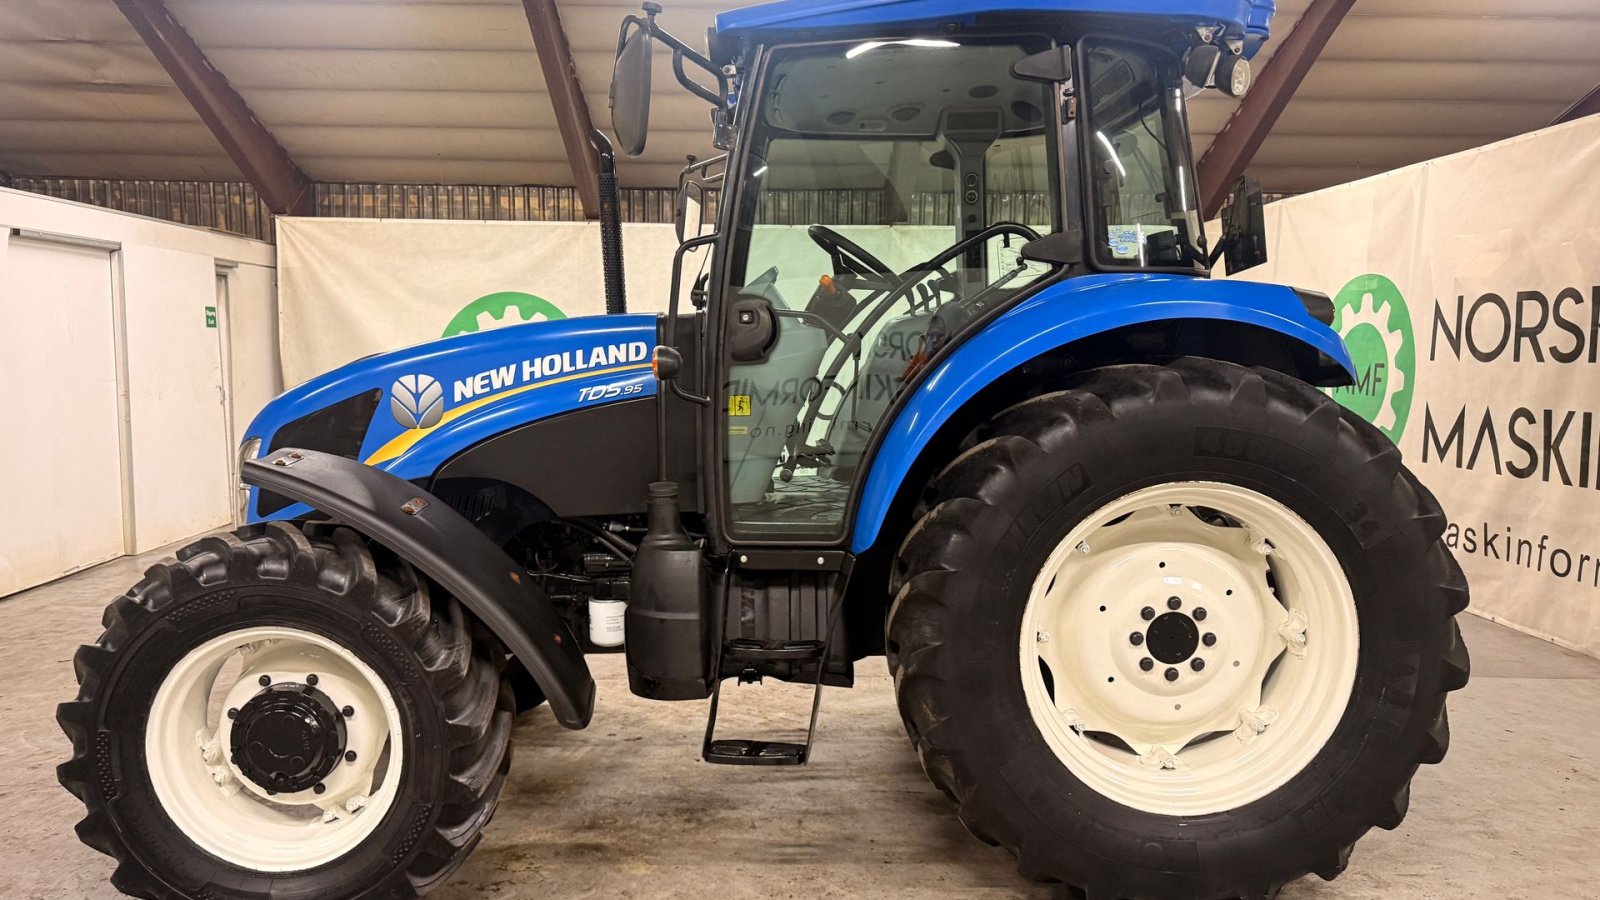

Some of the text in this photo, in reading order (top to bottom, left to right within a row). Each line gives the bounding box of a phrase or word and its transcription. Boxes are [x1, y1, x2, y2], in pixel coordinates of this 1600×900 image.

[454, 341, 648, 402] NEW HOLLAND
[1335, 363, 1385, 397] MF
[1421, 400, 1600, 491] MASKI
[1446, 521, 1600, 588] askinfor
